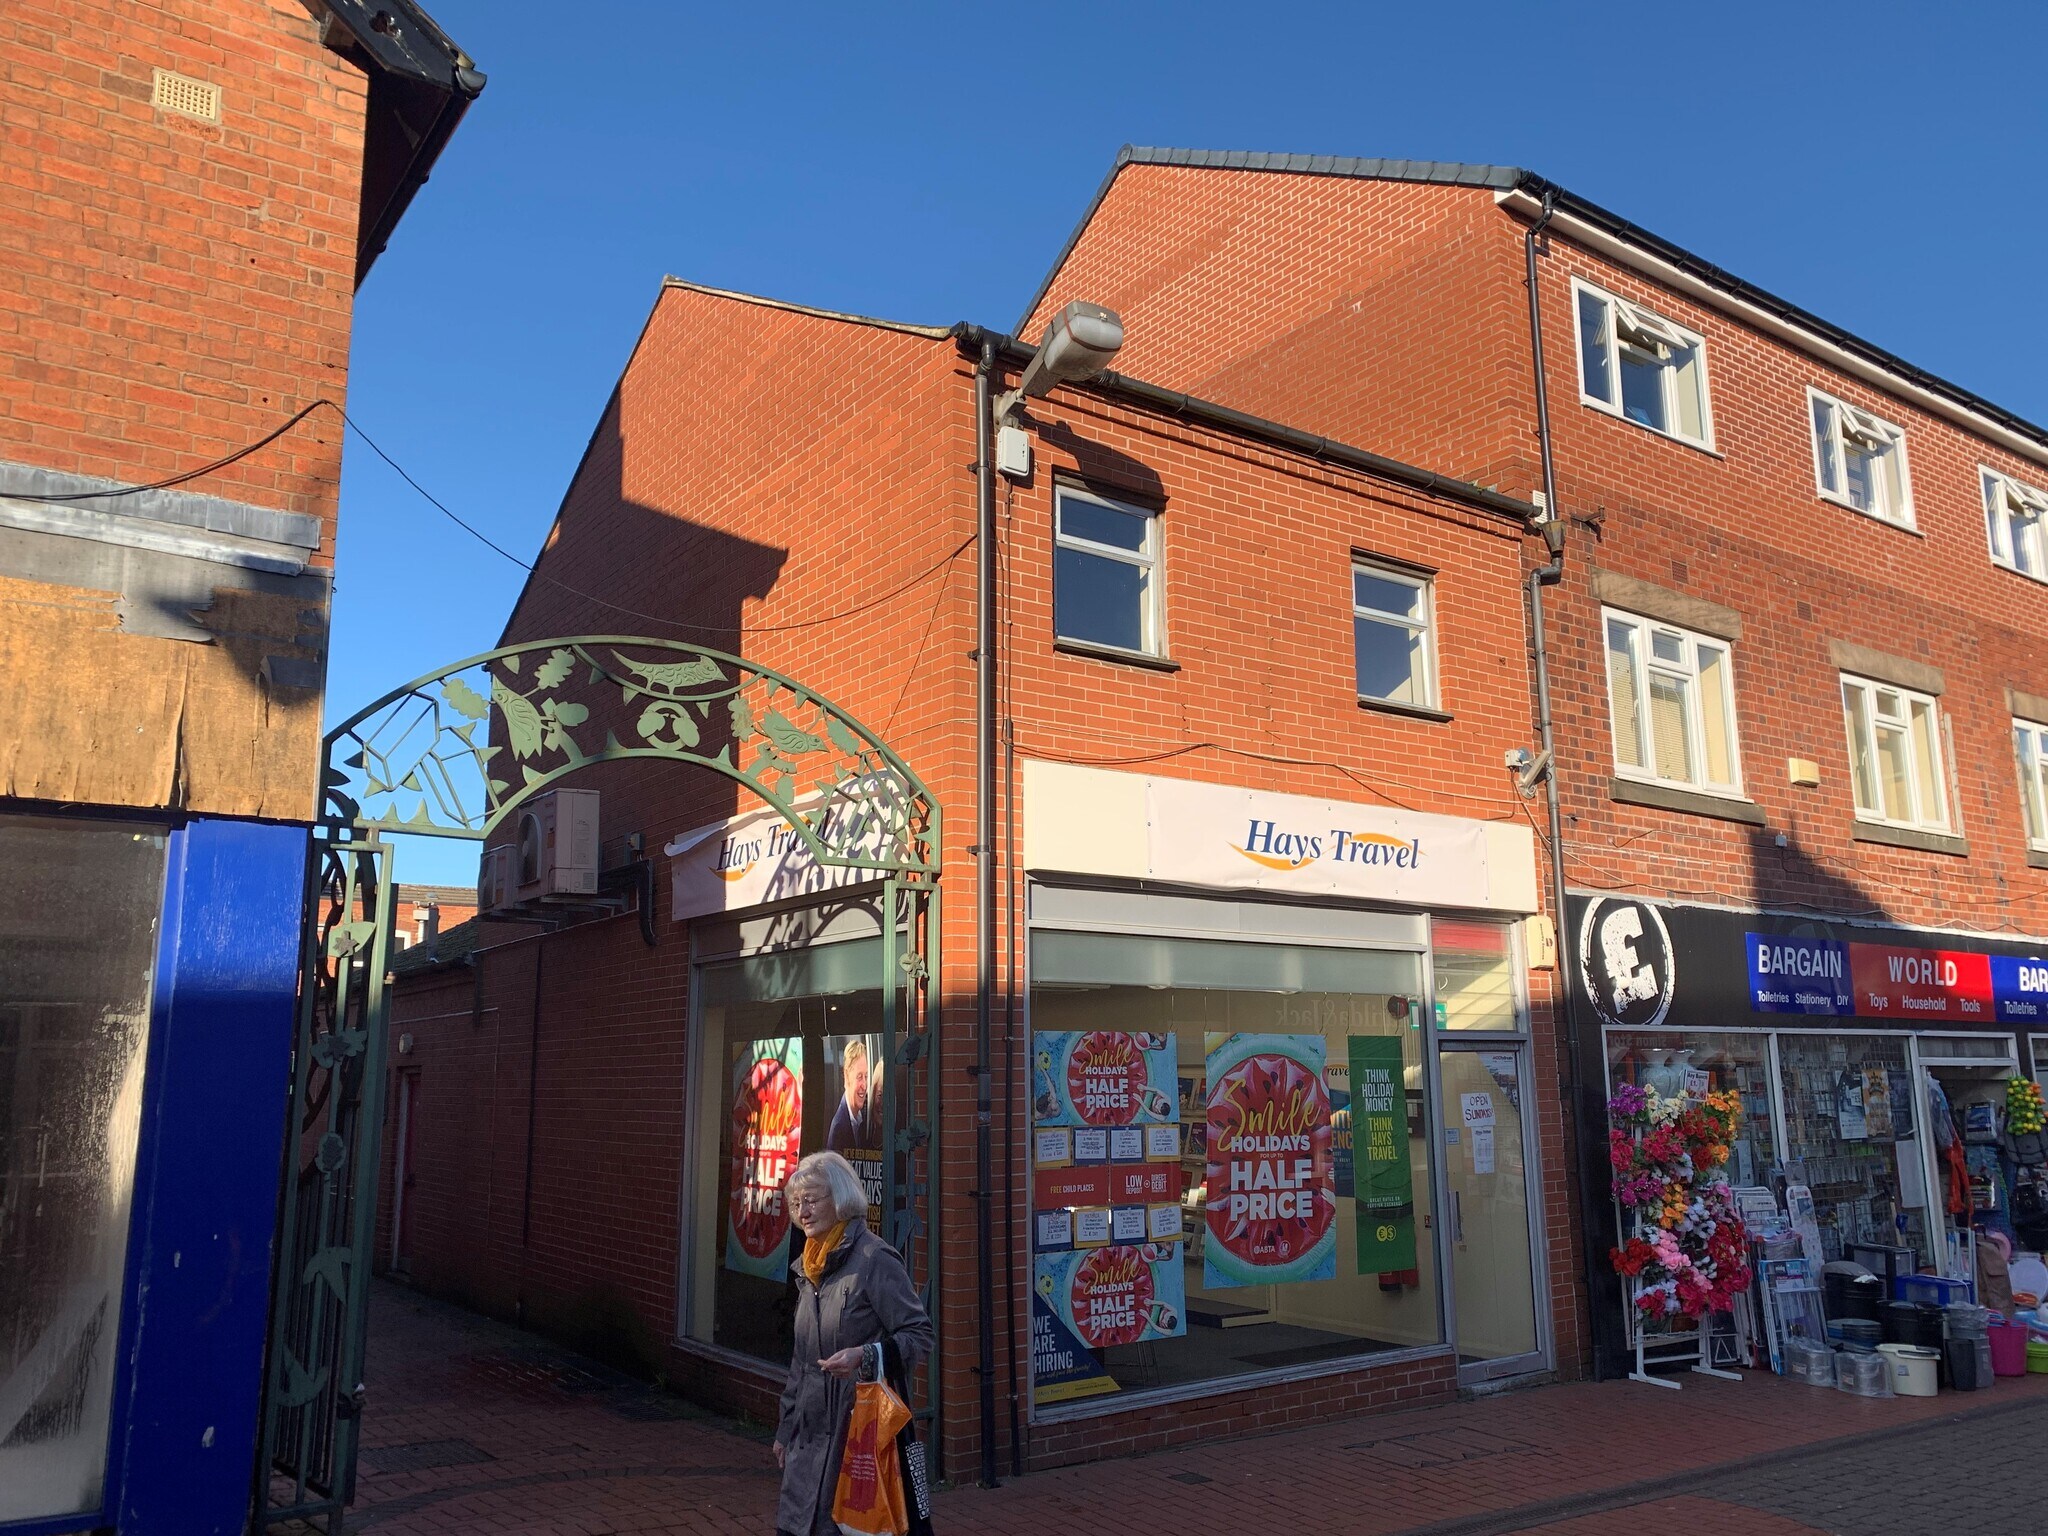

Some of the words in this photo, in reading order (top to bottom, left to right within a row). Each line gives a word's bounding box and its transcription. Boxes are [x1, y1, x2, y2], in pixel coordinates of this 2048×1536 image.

[1245, 819, 1322, 866] Hays
[1330, 829, 1420, 870] Travel
[717, 836, 762, 873] Hays
[1758, 944, 1842, 978] BARGAIN
[1888, 955, 1958, 987] WORLD
[1757, 990, 1789, 1003] Toiletries
[1795, 992, 1831, 1007] Stationery
[1837, 995, 1849, 1006] DIY
[1869, 993, 1888, 1011] Toys
[1902, 995, 1946, 1011] Household
[1960, 998, 1981, 1013] Tools
[2005, 1001, 2037, 1015] Toiletries
[1086, 1066, 1128, 1075] HOLIDAYS
[1365, 1069, 1390, 1084] THINK
[1086, 1078, 1128, 1094] HALF
[1362, 1083, 1395, 1098] HOLIDAY
[1086, 1094, 1129, 1108] PRICE
[1365, 1098, 1393, 1112] MONEY
[1470, 1094, 1488, 1106] OPEN
[1217, 1078, 1322, 1152] Smile
[1368, 1117, 1393, 1133] THINK
[745, 1134, 787, 1152] HOLIDAYS
[1231, 1135, 1310, 1153] HOLIDAYS
[1371, 1132, 1393, 1146] HAYS
[1366, 1145, 1398, 1161] TRAVEL
[742, 1156, 786, 1188] HALF
[863, 1160, 883, 1179] VALUE
[1151, 1173, 1167, 1181] DIRECT
[1230, 1159, 1312, 1191] HALF
[1050, 1185, 1062, 1194] FREE
[1063, 1184, 1077, 1193] CHILD
[1077, 1184, 1094, 1193] PLACES
[1125, 1174, 1143, 1187] LOW
[1151, 1180, 1167, 1190] DEBIT
[740, 1186, 783, 1217] PRICE
[1230, 1191, 1314, 1222] PRICE
[1090, 1282, 1134, 1295] HOLIDAYS
[1090, 1295, 1135, 1314] HALF
[1033, 1315, 1051, 1334] WE
[1091, 1312, 1136, 1331] PRICE
[1034, 1334, 1056, 1354] ARE
[1034, 1350, 1073, 1374] HIRING
